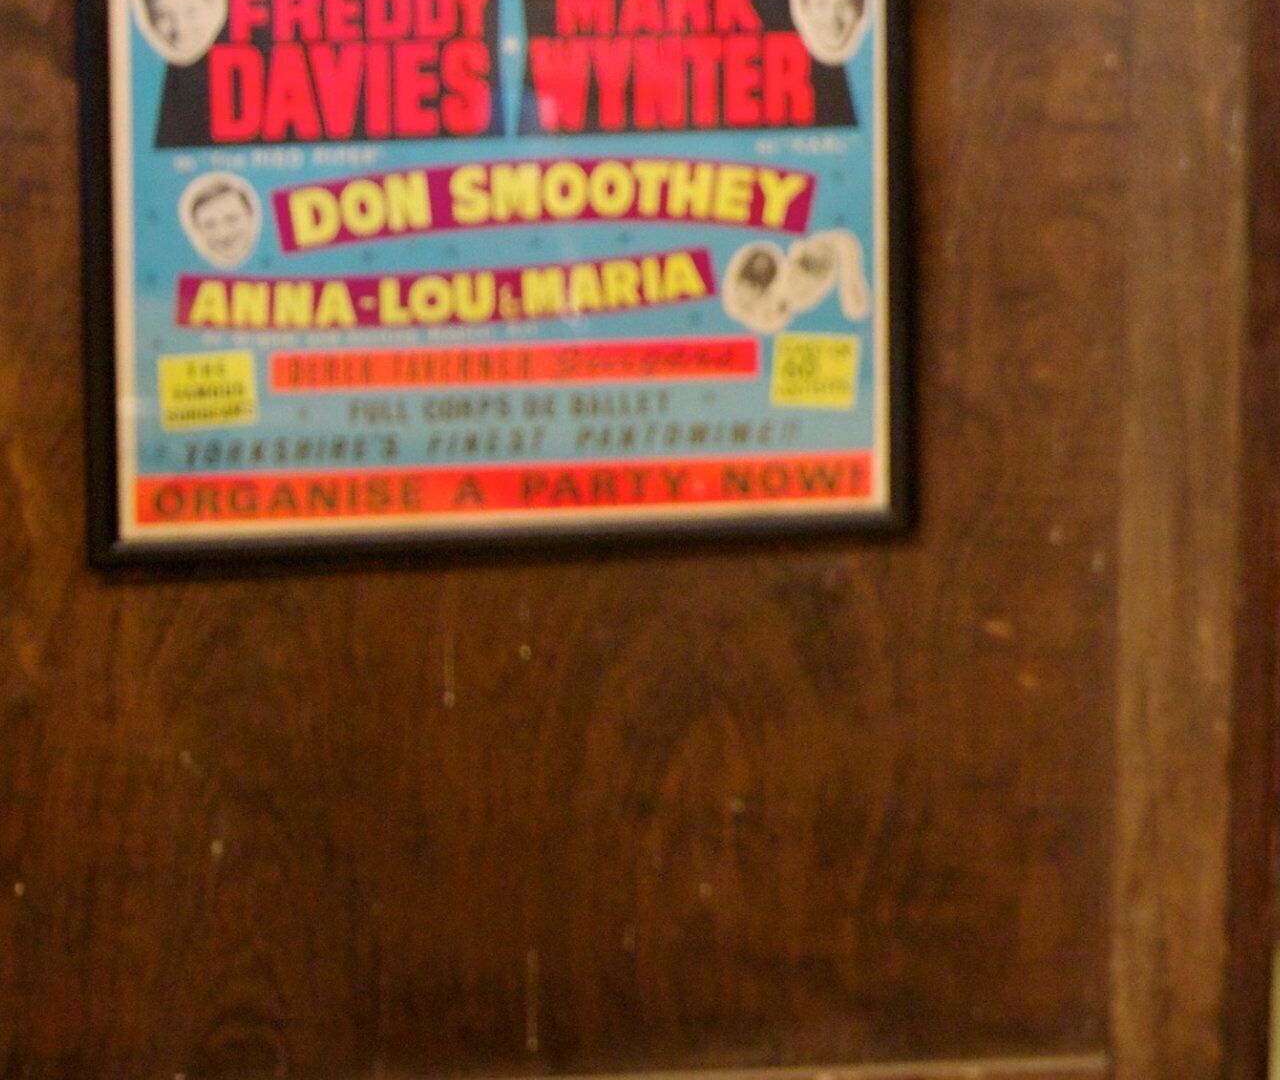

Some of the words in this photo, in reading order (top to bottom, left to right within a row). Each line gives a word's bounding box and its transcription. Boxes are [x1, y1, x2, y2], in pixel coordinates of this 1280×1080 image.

[209, 40, 493, 144] DAVIES
[528, 32, 815, 134] WYNTER
[288, 170, 433, 248] DON
[449, 159, 807, 228] SMOOTHEY
[189, 272, 497, 328] ANNA-LOU
[520, 251, 708, 318] MARIA
[569, 390, 670, 418] BALLET
[153, 475, 423, 518] ORGANISE
[453, 475, 484, 507] A
[520, 465, 689, 503] PARTY
[720, 461, 864, 496] NOW!
